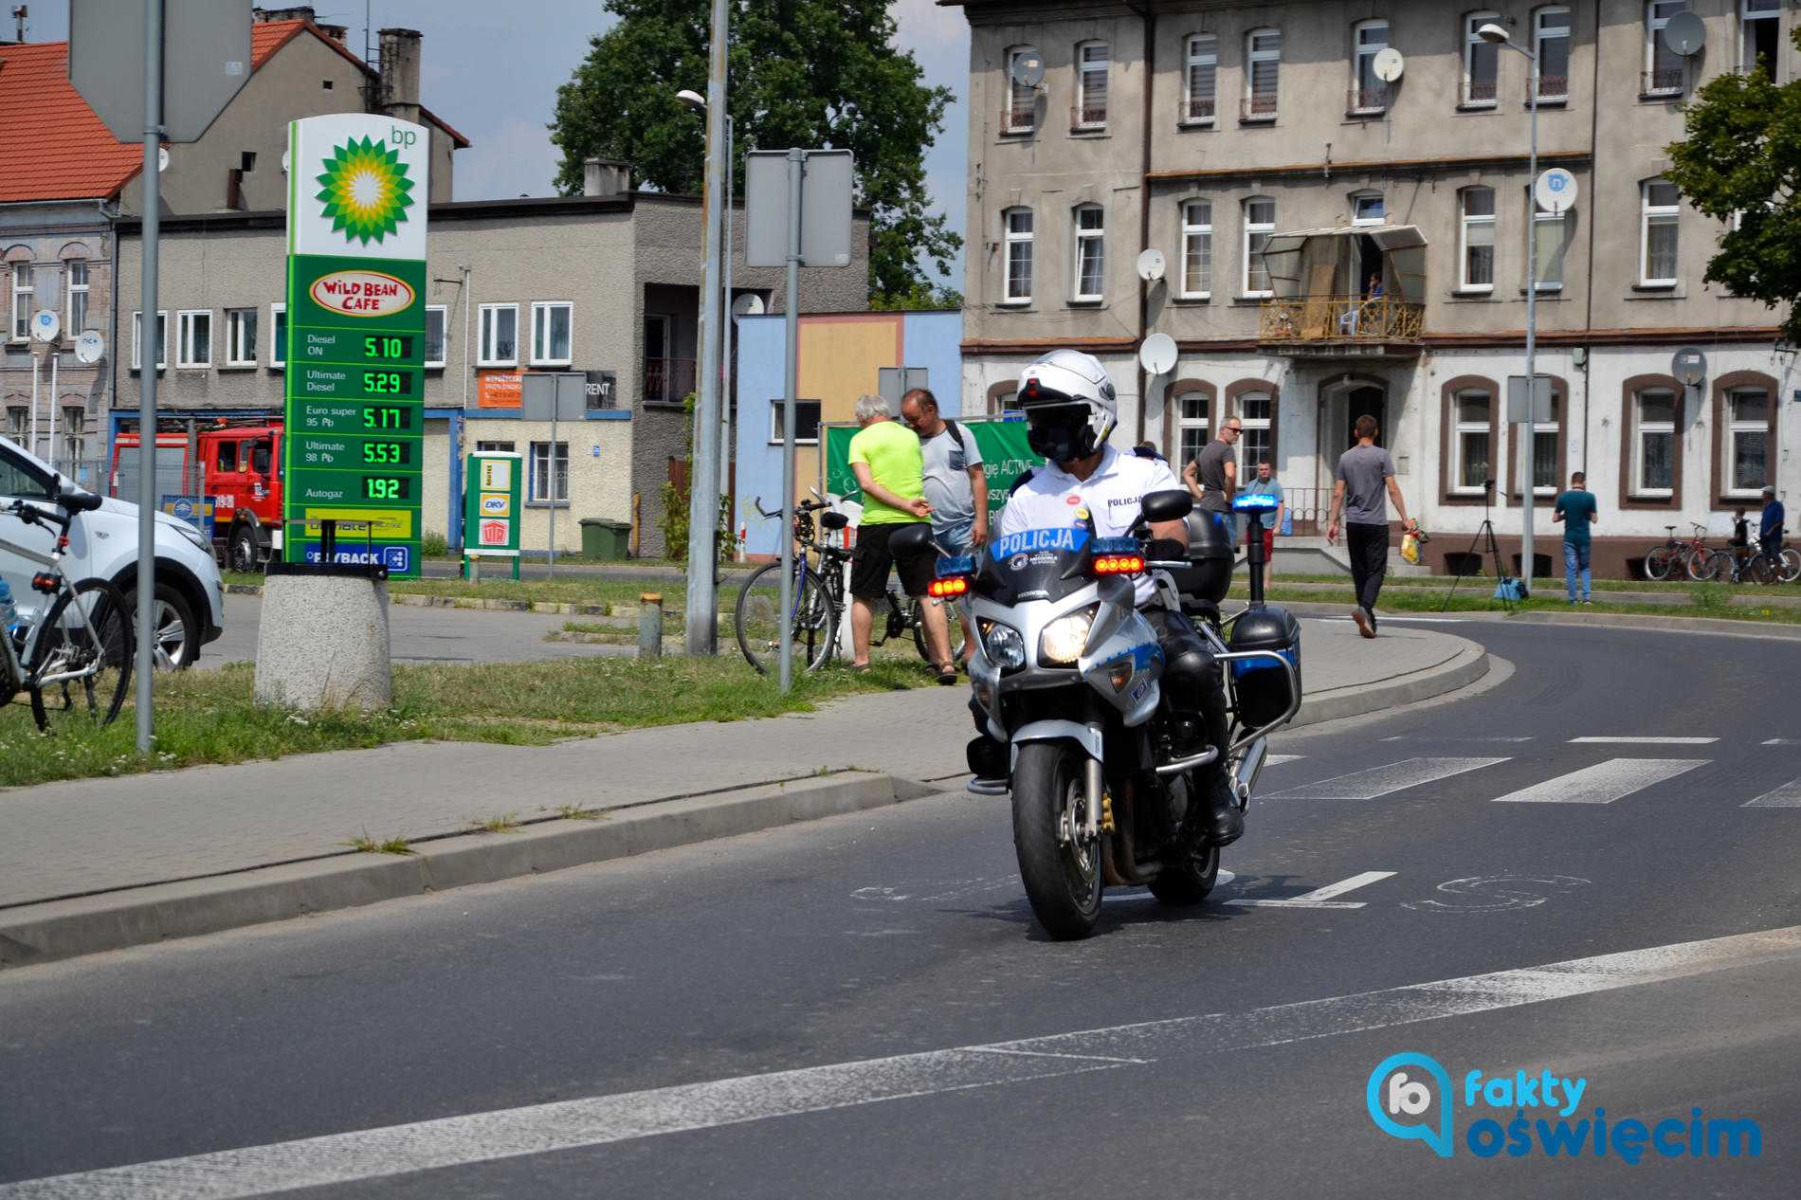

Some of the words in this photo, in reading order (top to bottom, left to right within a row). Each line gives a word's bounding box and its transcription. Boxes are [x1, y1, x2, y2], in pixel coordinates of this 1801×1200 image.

[391, 125, 416, 148] bp
[364, 283, 397, 297] BEAN
[342, 296, 380, 310] CAFE
[307, 334, 336, 344] Diesel
[307, 346, 323, 356] ON
[365, 337, 402, 358] 5.10
[307, 370, 346, 380] Ultimate
[306, 381, 335, 392] Diesel
[364, 373, 400, 393] 5.29
[306, 405, 328, 415] Euro
[331, 408, 356, 417] super
[306, 418, 318, 427] 95
[363, 408, 400, 428] 5.17
[306, 441, 345, 451] Ultimate
[305, 453, 318, 463] 98
[364, 443, 400, 463] 5.53
[305, 488, 344, 499] Autogaz
[485, 501, 505, 509] DKV
[1000, 529, 1075, 559] POLICJA
